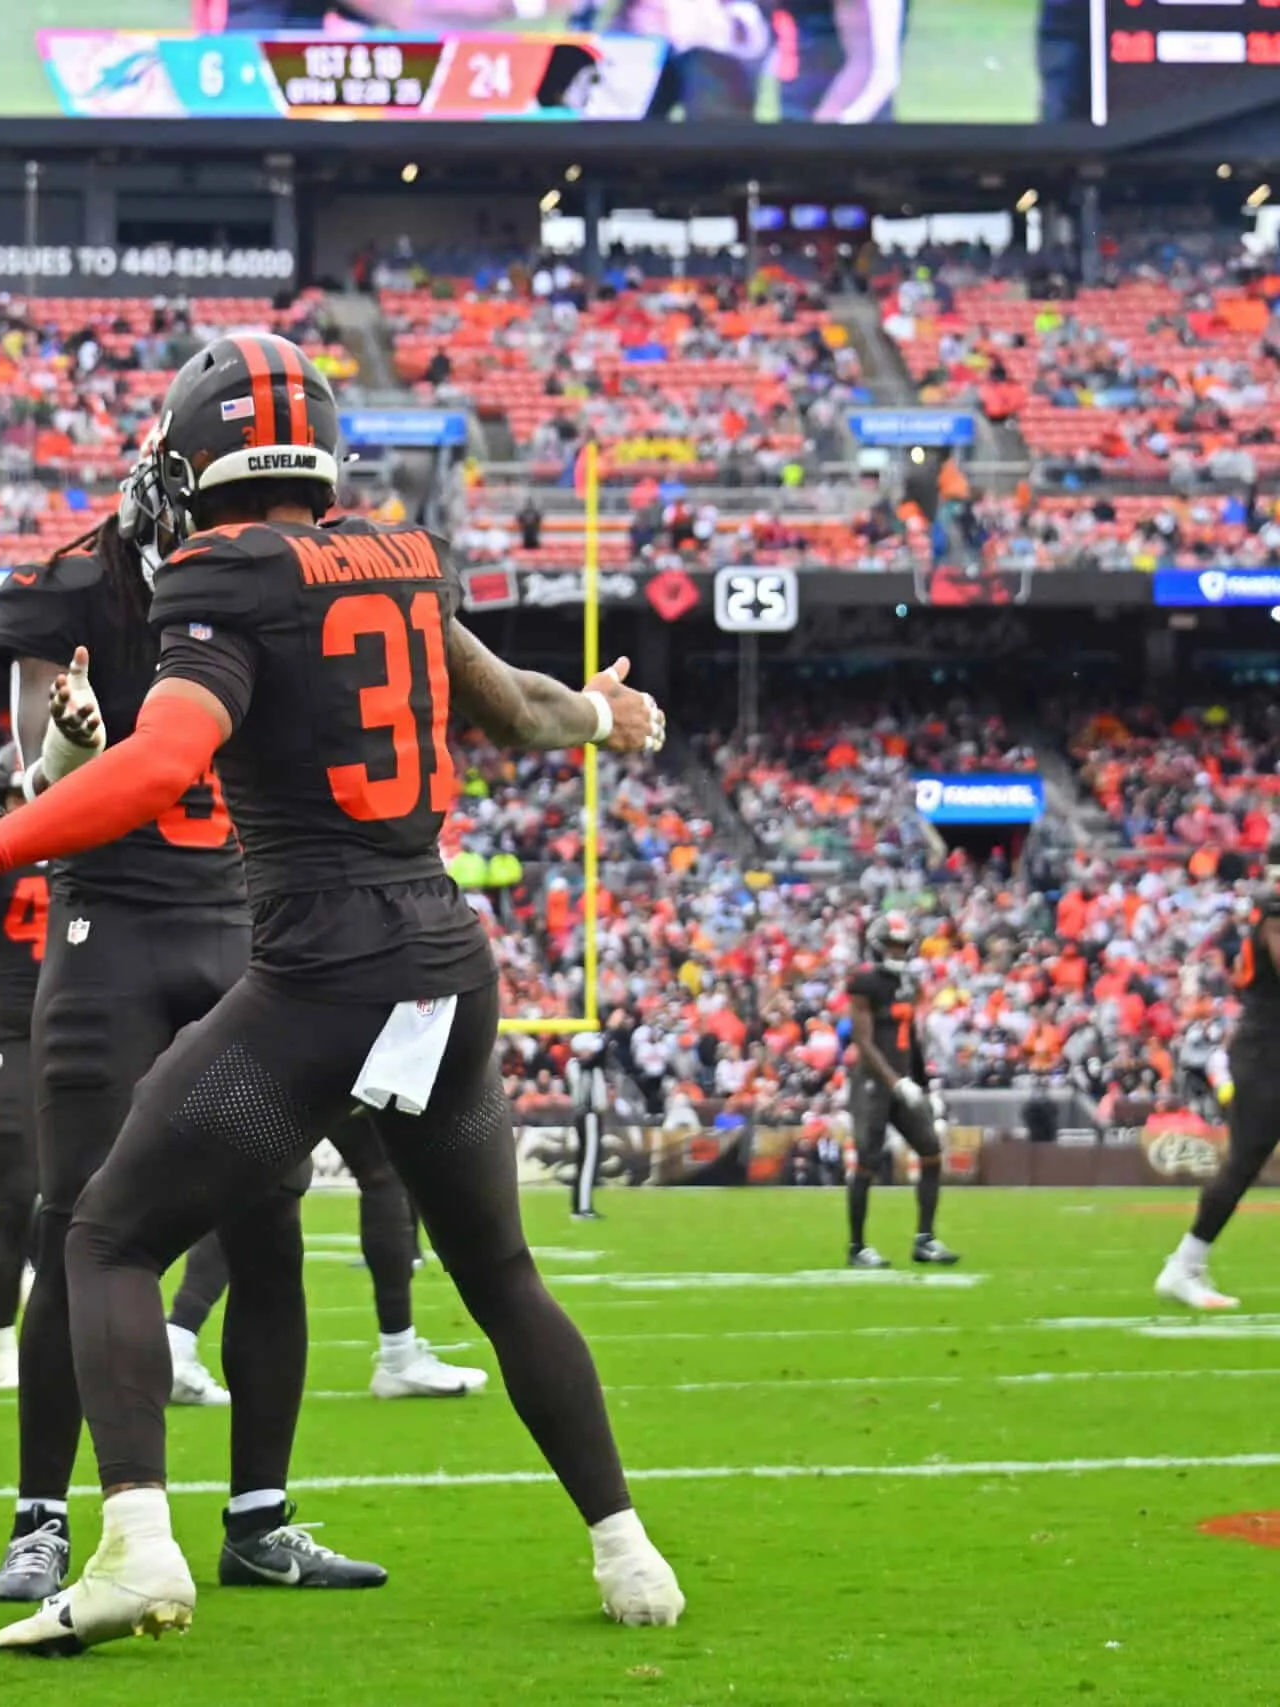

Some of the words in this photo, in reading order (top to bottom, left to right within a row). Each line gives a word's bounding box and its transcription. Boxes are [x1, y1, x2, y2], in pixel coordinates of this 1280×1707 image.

[199, 52, 224, 97] 6
[469, 54, 510, 98] 24
[77, 248, 118, 276] TO
[247, 454, 318, 471] CLEVELAND
[727, 576, 786, 622] 25
[322, 591, 455, 822] 31
